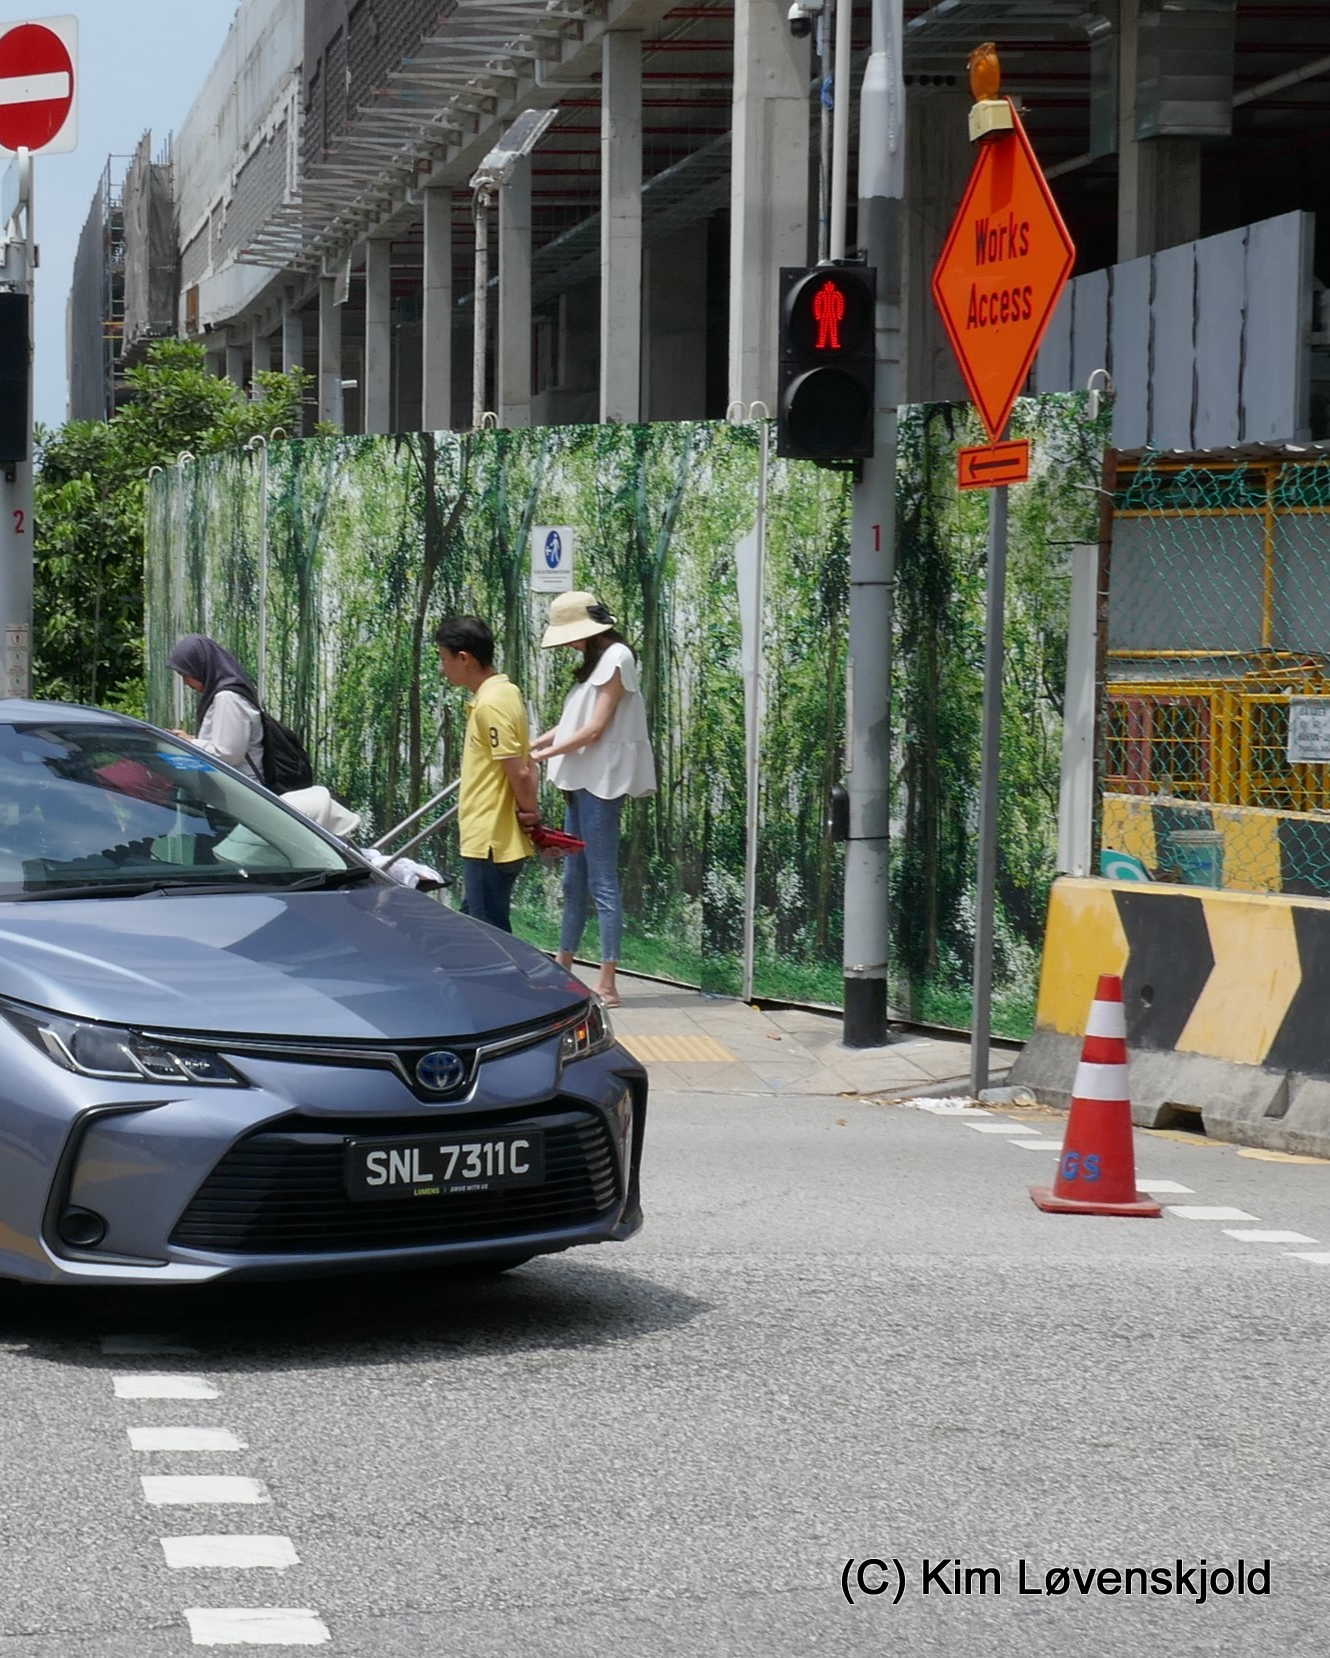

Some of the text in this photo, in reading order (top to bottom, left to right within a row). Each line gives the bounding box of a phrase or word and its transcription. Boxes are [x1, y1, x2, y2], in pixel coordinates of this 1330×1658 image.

[975, 212, 1030, 266] Works
[966, 283, 1032, 330] Access
[13, 509, 25, 534] 2
[871, 524, 881, 552] 1
[366, 1139, 530, 1186] SNL 7311C
